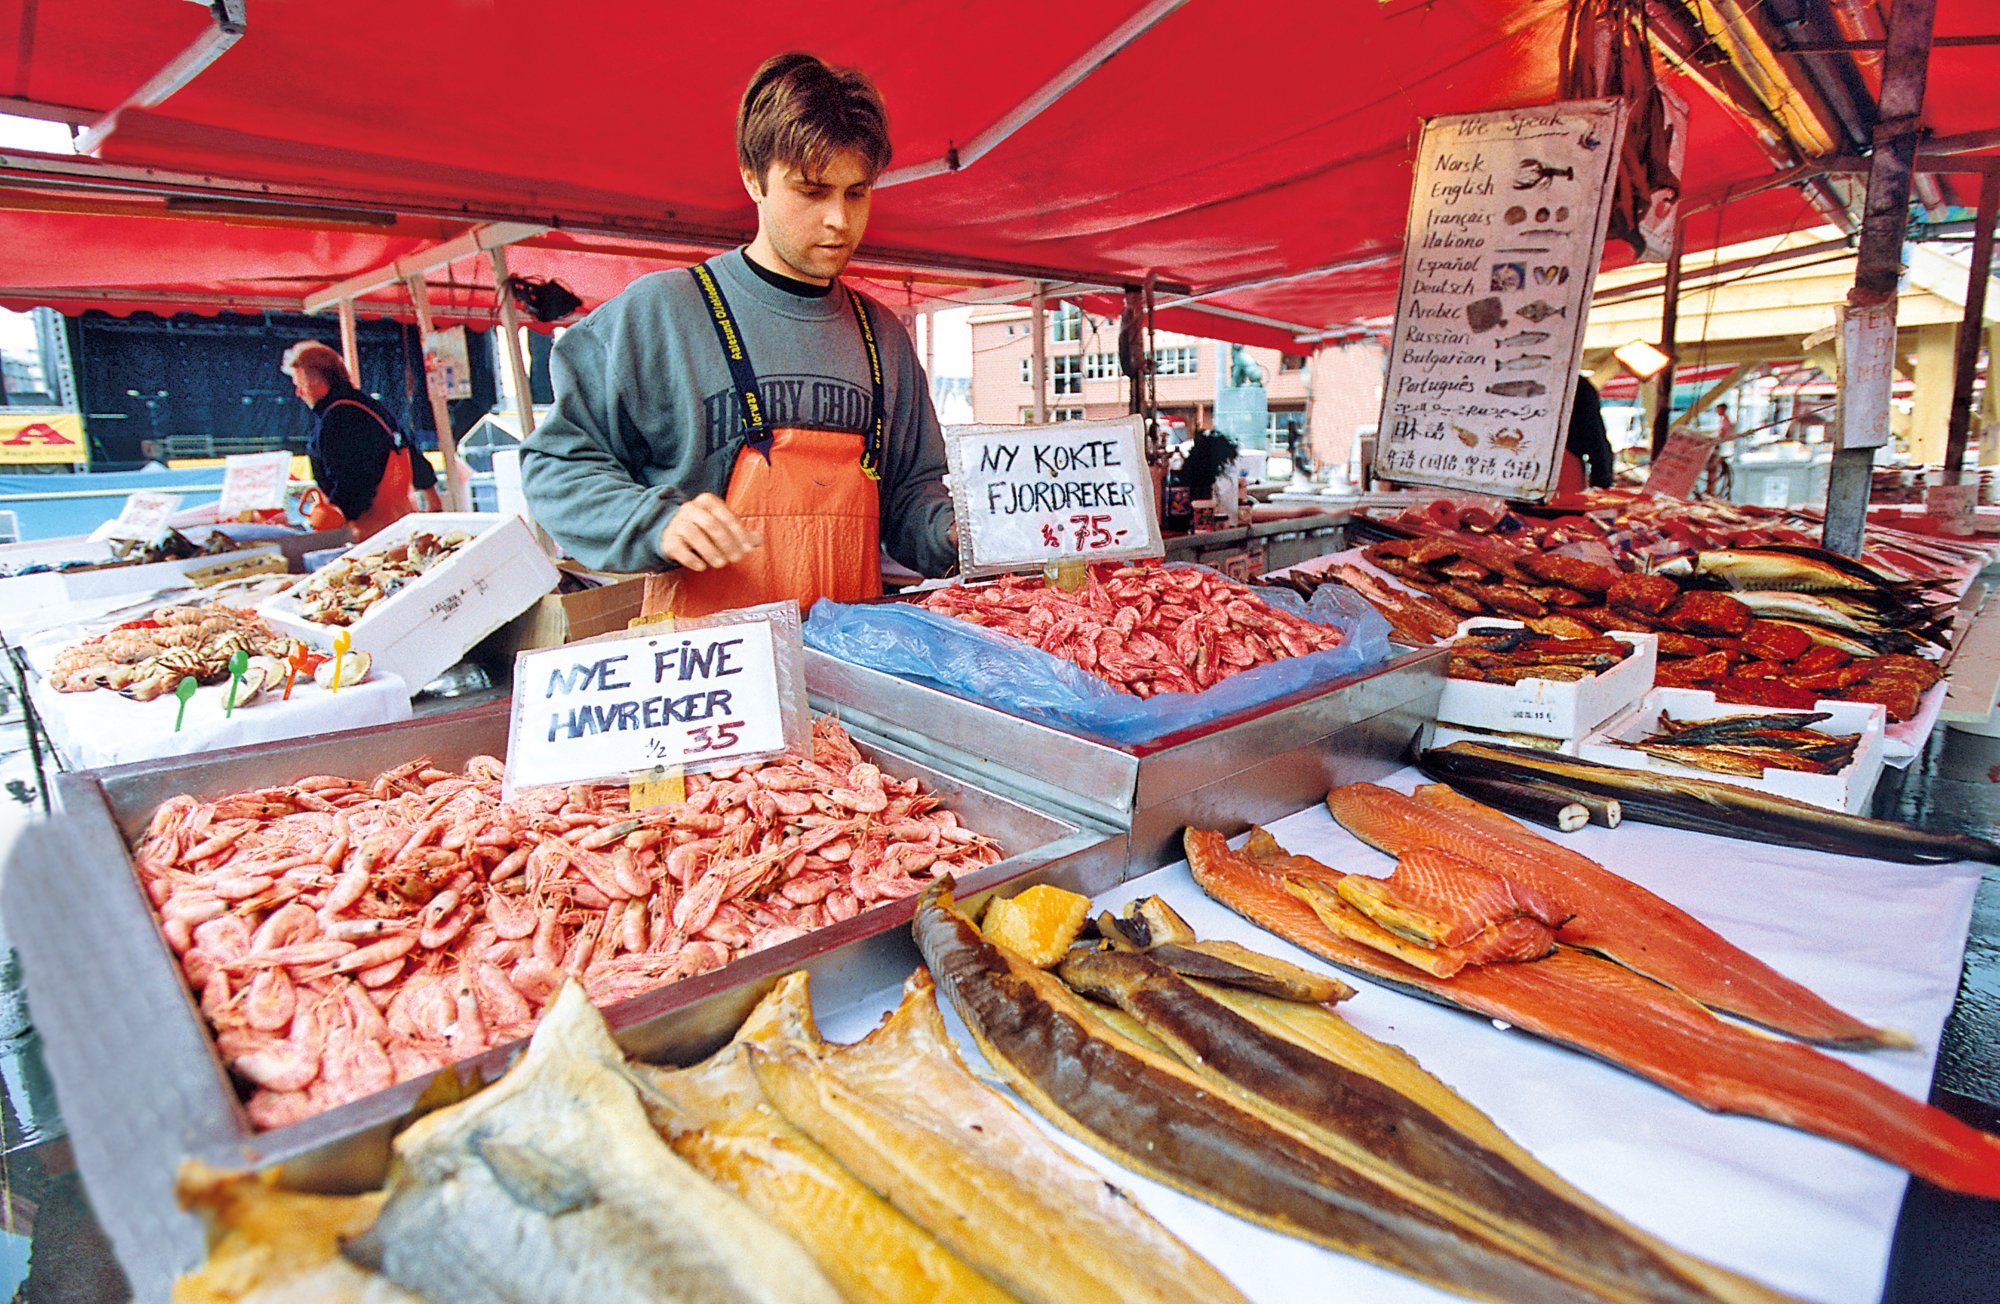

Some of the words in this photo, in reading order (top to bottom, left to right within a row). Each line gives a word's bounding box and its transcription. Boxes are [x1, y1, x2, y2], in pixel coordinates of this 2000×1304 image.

[1458, 117, 1488, 136] We
[1507, 108, 1564, 137] Speak
[1434, 153, 1485, 173] Norsk
[1430, 174, 1495, 205] English
[1412, 277, 1475, 295] Deutsch
[1408, 299, 1462, 319] Arabic
[1405, 325, 1472, 345] Russian
[1402, 348, 1487, 373] Bulgarian
[1397, 374, 1475, 400] Português
[980, 444, 1020, 472] NY
[1033, 440, 1121, 475] KOKTE
[988, 481, 1136, 514] FJORDREKER
[546, 654, 631, 699] NYE
[548, 689, 733, 742] HAVREKER
[683, 720, 746, 755] 35
